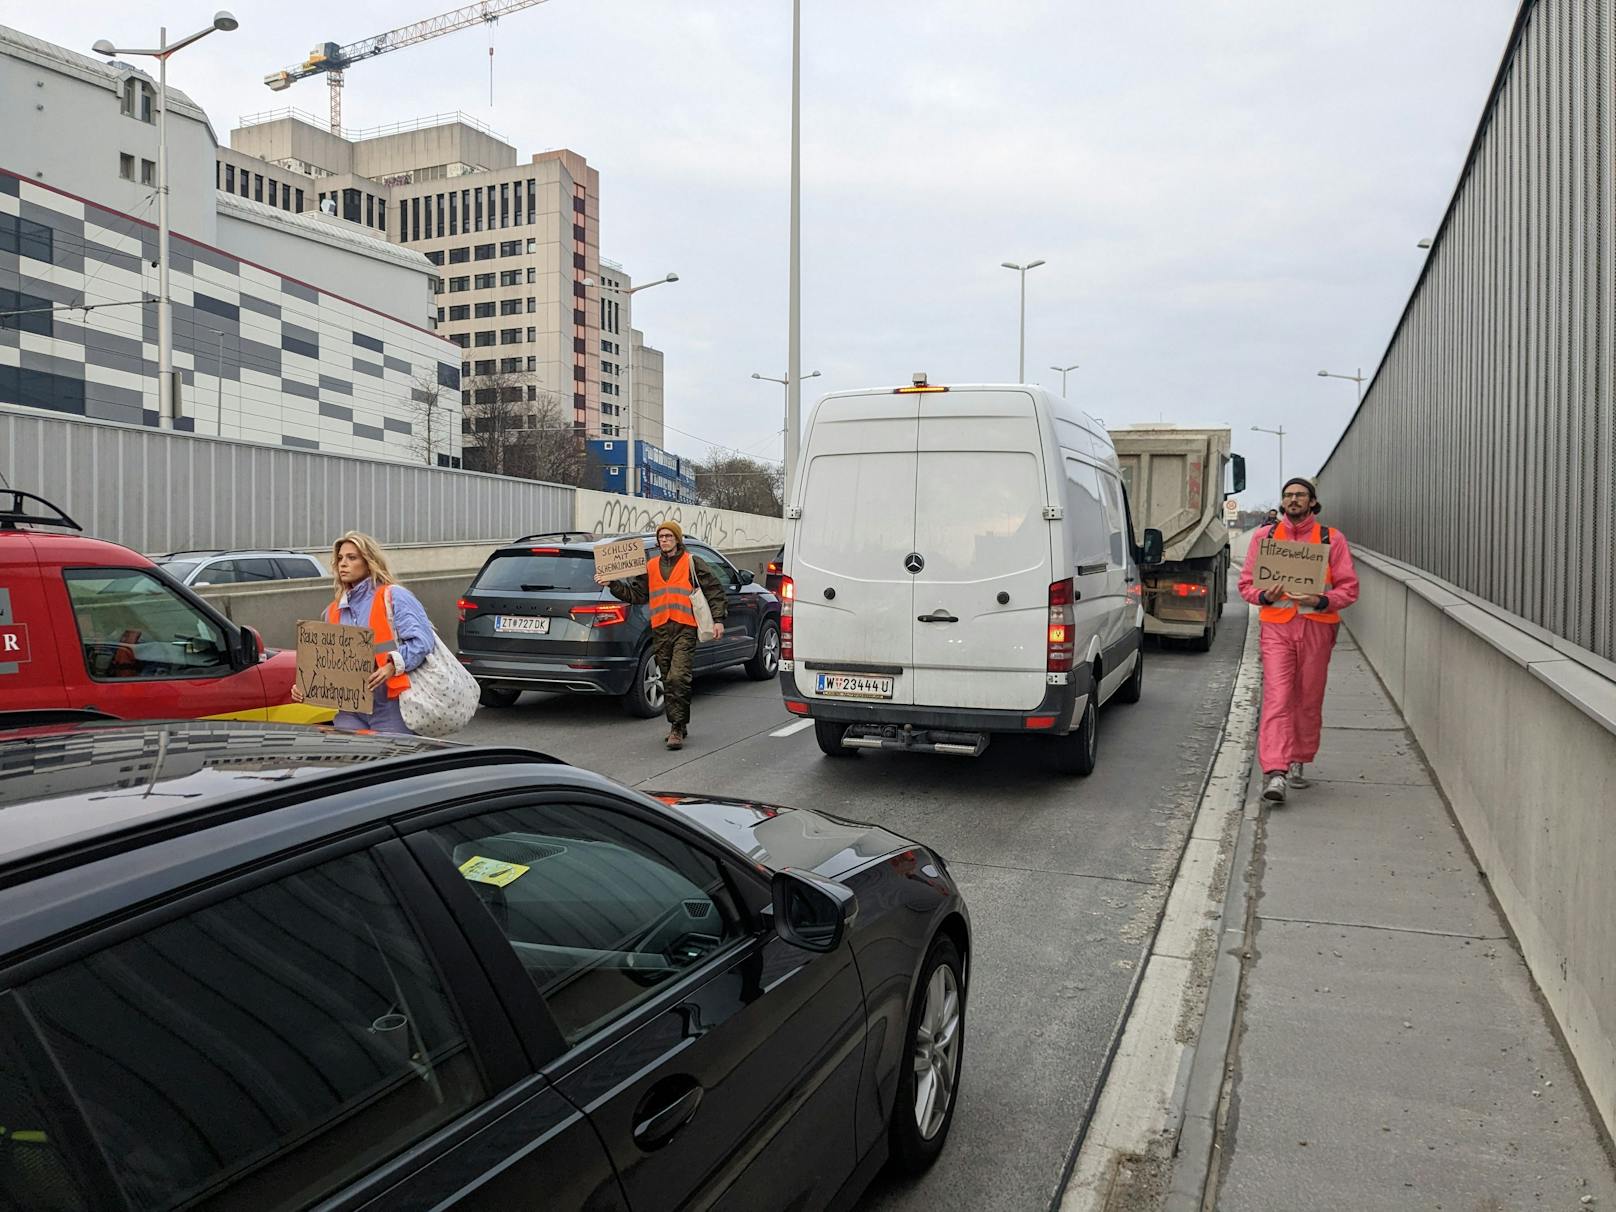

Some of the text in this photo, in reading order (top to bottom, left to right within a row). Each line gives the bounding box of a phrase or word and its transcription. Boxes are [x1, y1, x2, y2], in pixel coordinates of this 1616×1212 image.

[602, 541, 639, 557] SCHLUSS
[613, 552, 629, 561] MIT
[1260, 538, 1324, 562] Hitzewellen
[1259, 566, 1315, 585] Dürren
[300, 626, 353, 647] Raus aus der
